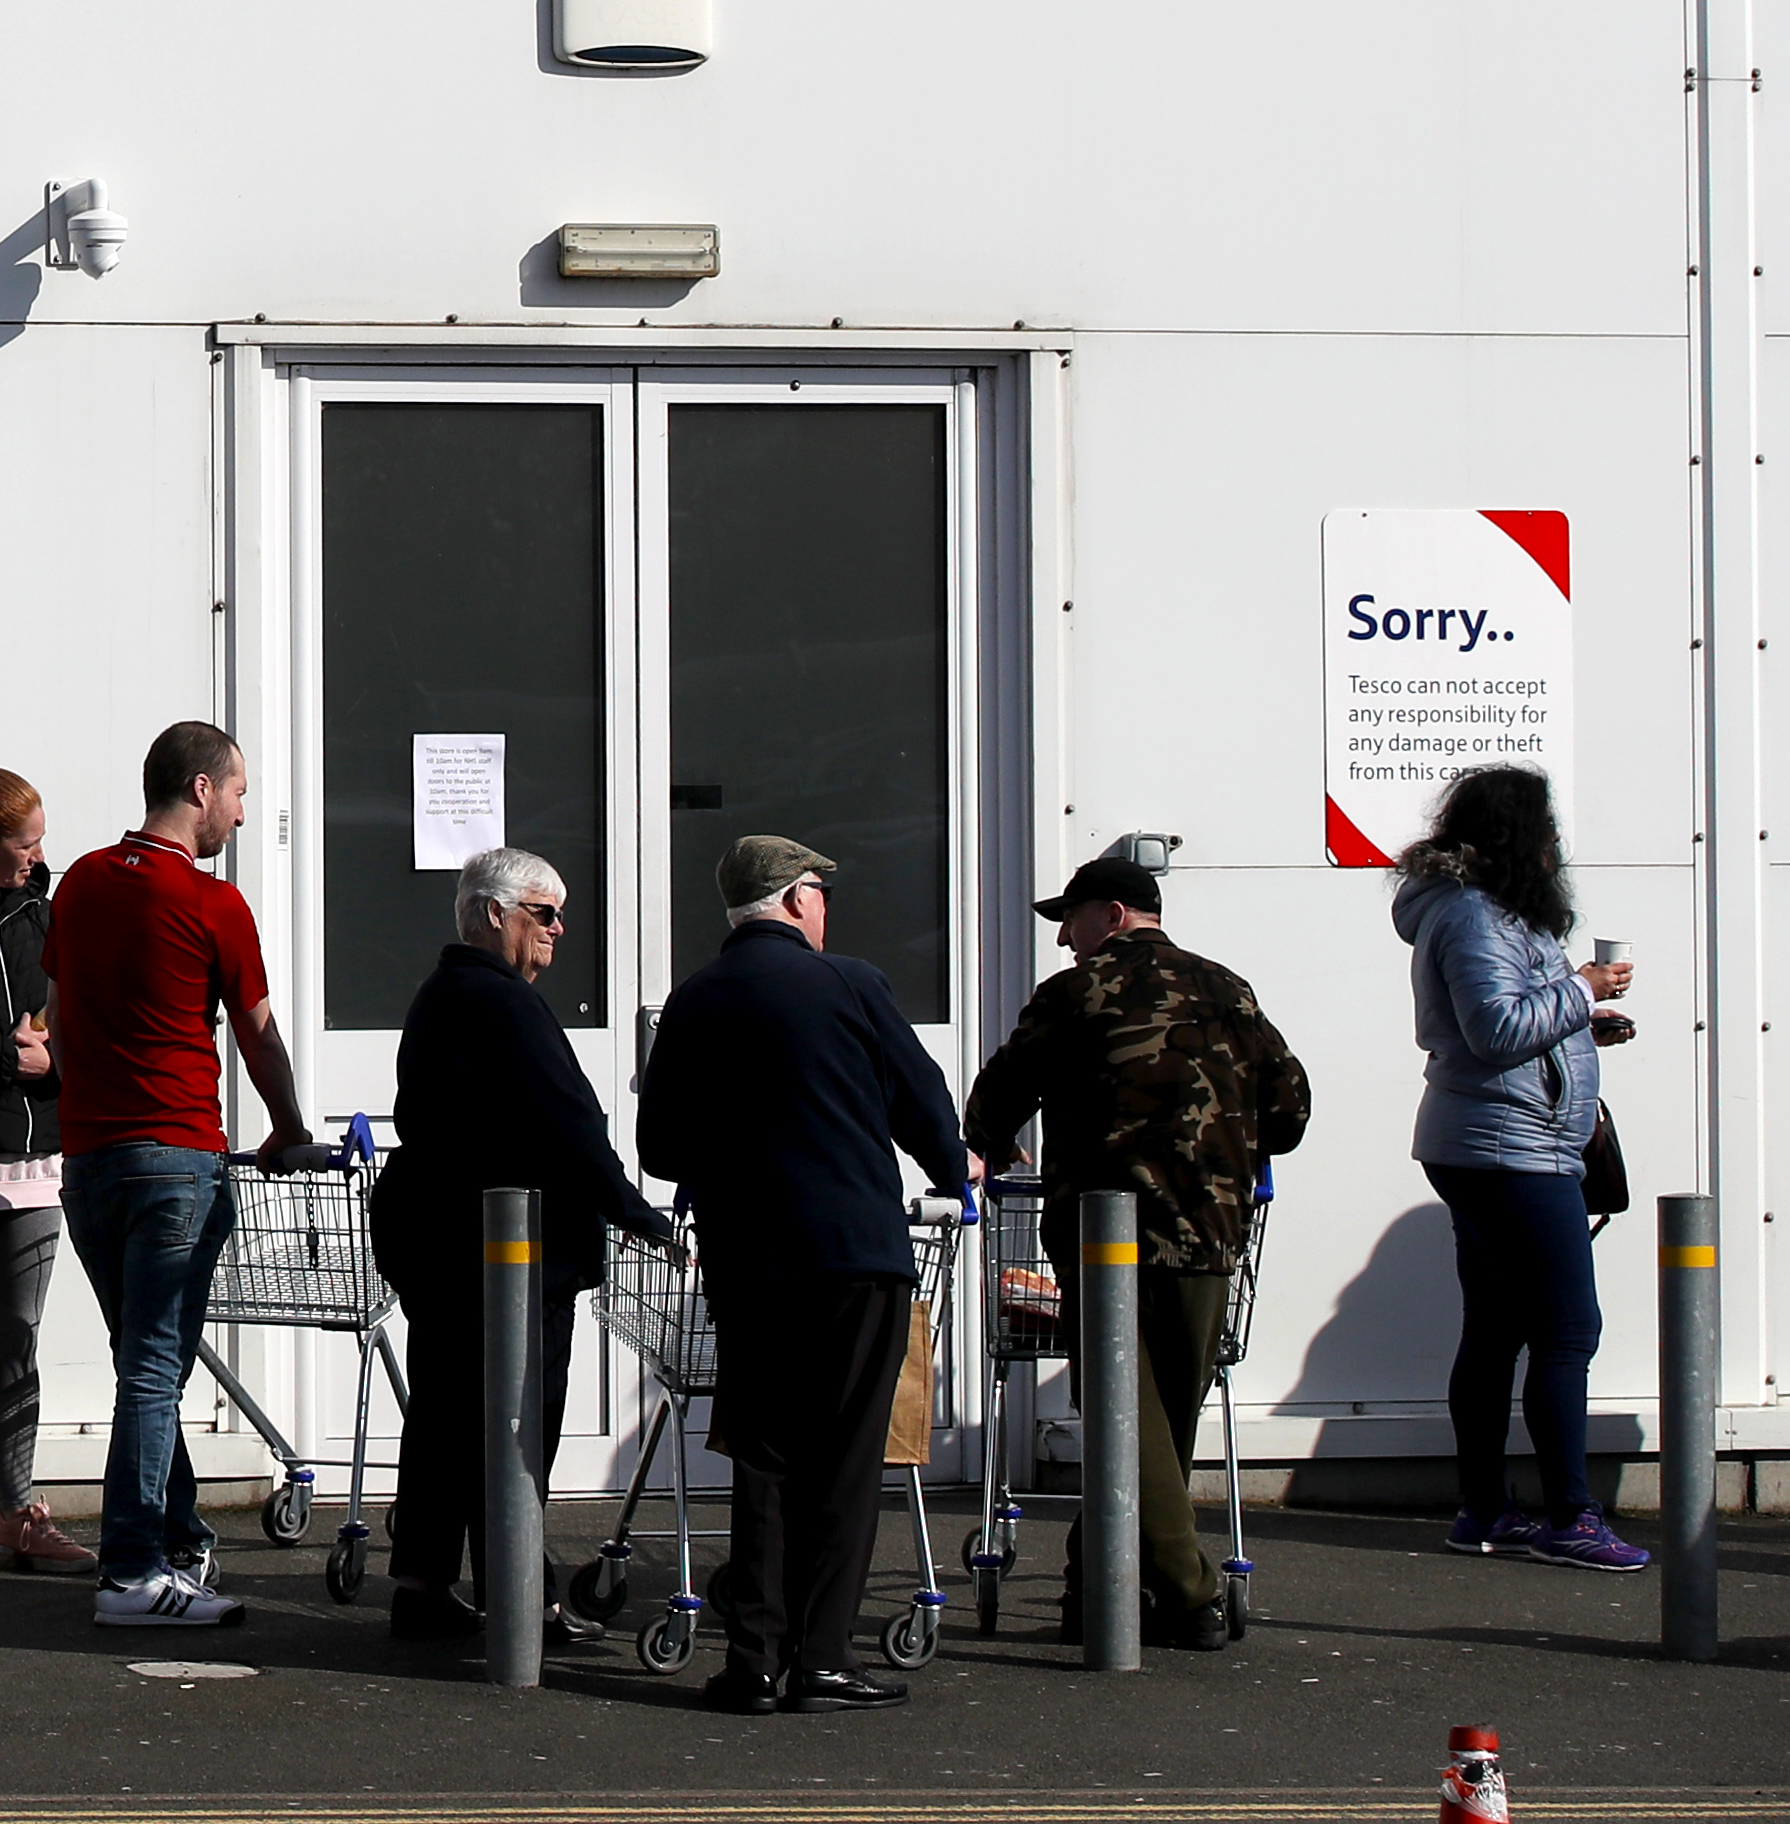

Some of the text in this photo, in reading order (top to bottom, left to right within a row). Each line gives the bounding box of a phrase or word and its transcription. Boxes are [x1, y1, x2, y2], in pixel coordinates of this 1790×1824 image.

[1347, 593, 1515, 653] Sorry..
[1348, 674, 1547, 700] Tesco can not accept
[1348, 704, 1547, 728] any responsibility for
[1348, 732, 1543, 756] any damage or theft
[1348, 761, 1394, 780] from
[1399, 761, 1434, 781] this
